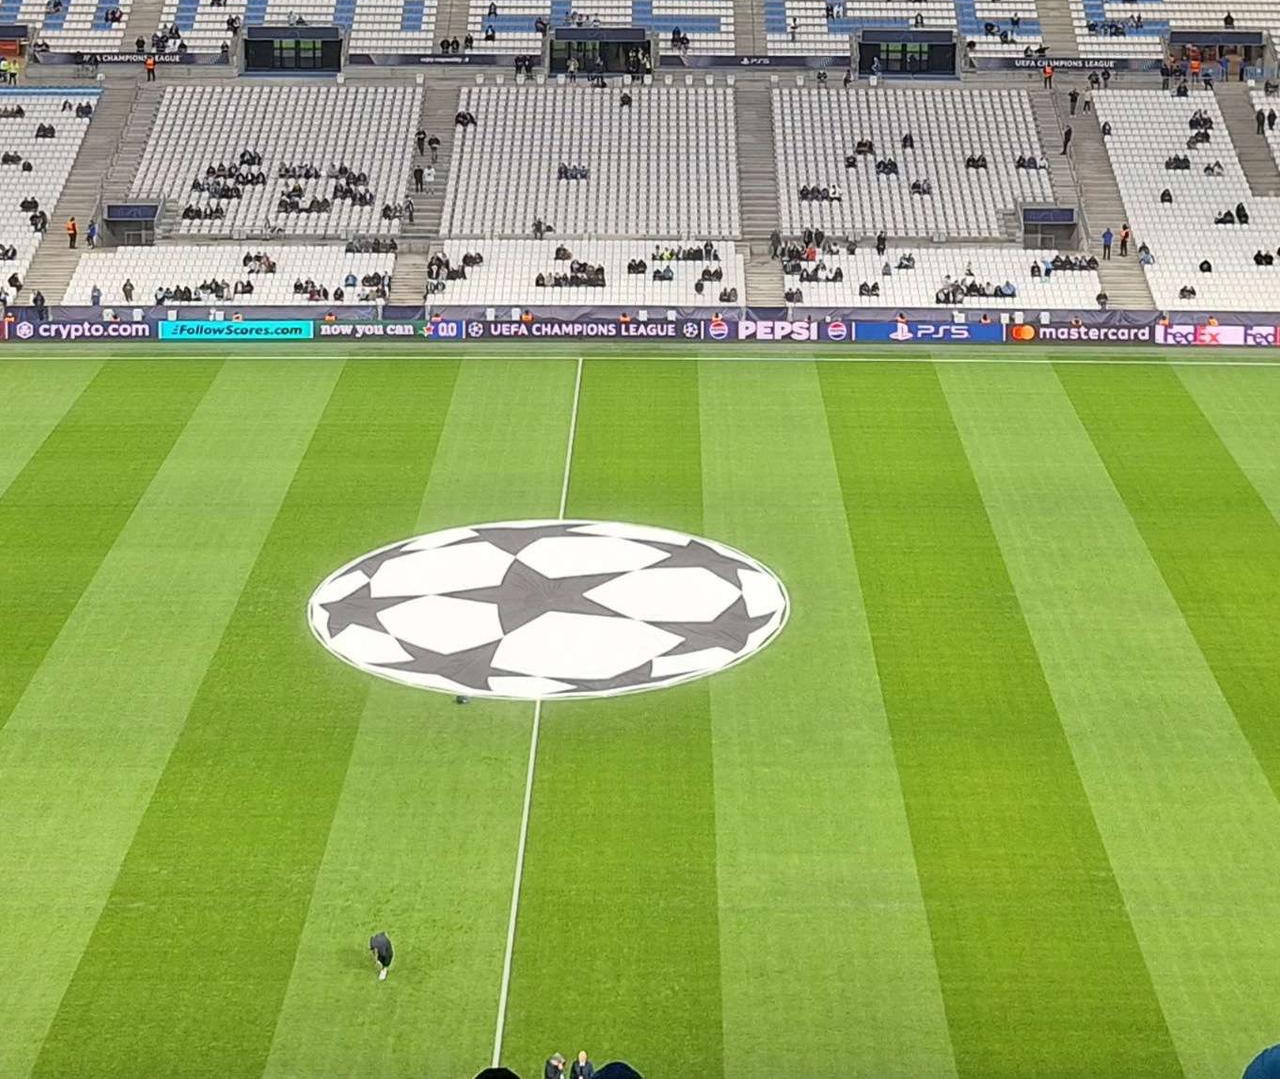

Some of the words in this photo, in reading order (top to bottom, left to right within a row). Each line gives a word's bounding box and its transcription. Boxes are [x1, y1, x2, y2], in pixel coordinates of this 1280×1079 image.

[39, 321, 150, 340] crypto.com
[178, 324, 303, 336] FollowScores.com
[320, 324, 354, 335] now
[355, 324, 384, 338] you
[386, 324, 414, 335] can
[490, 323, 528, 336] UEFA
[531, 323, 617, 336] CHAMPIONS
[621, 323, 676, 336] LEAGUE
[738, 320, 818, 340] PEPSI
[917, 324, 969, 338] PS5
[1038, 323, 1150, 340] mastercard
[1165, 326, 1220, 344] FedEx
